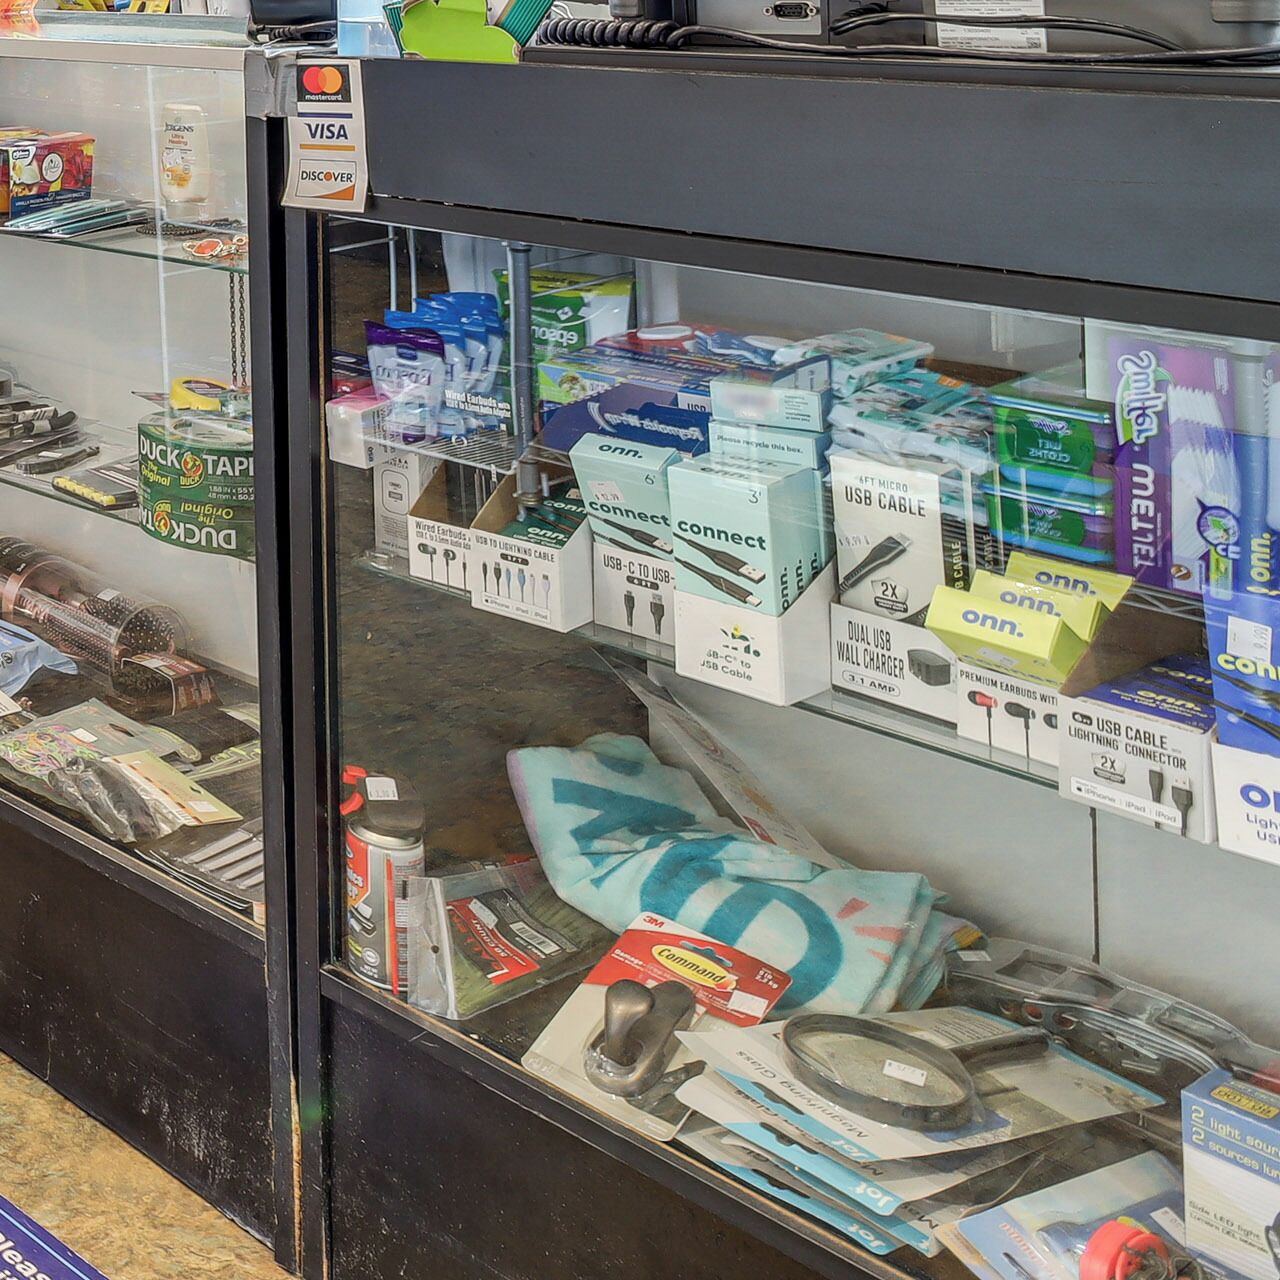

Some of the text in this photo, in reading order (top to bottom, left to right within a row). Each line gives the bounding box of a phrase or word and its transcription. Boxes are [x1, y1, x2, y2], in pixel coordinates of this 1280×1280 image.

[304, 93, 344, 101] mastercard.
[163, 121, 195, 133] JERGENS
[303, 122, 349, 140] VISA
[300, 170, 354, 183] DISCOVER
[139, 434, 181, 470] DUCK
[716, 433, 805, 455] Please recycle this box.
[180, 502, 234, 519] Original
[587, 498, 671, 528] connect
[844, 484, 928, 519] USB CABLE
[170, 519, 238, 550] DUCK
[676, 519, 767, 552] connect
[602, 553, 636, 575] USB-C
[637, 563, 650, 578] TO
[999, 589, 1062, 617] onn.
[846, 620, 892, 650] DUAL USB
[961, 607, 1025, 639] onn.
[836, 640, 905, 680] WALL CHARGER
[1068, 724, 1187, 771] LIGHTNING CONNECTOR
[1096, 717, 1169, 751] USB CABLE
[1084, 788, 1178, 825] iPhone iPad iPod
[642, 914, 666, 929] 3M
[657, 947, 728, 984] Command
[1191, 1126, 1261, 1171] 2 sources
